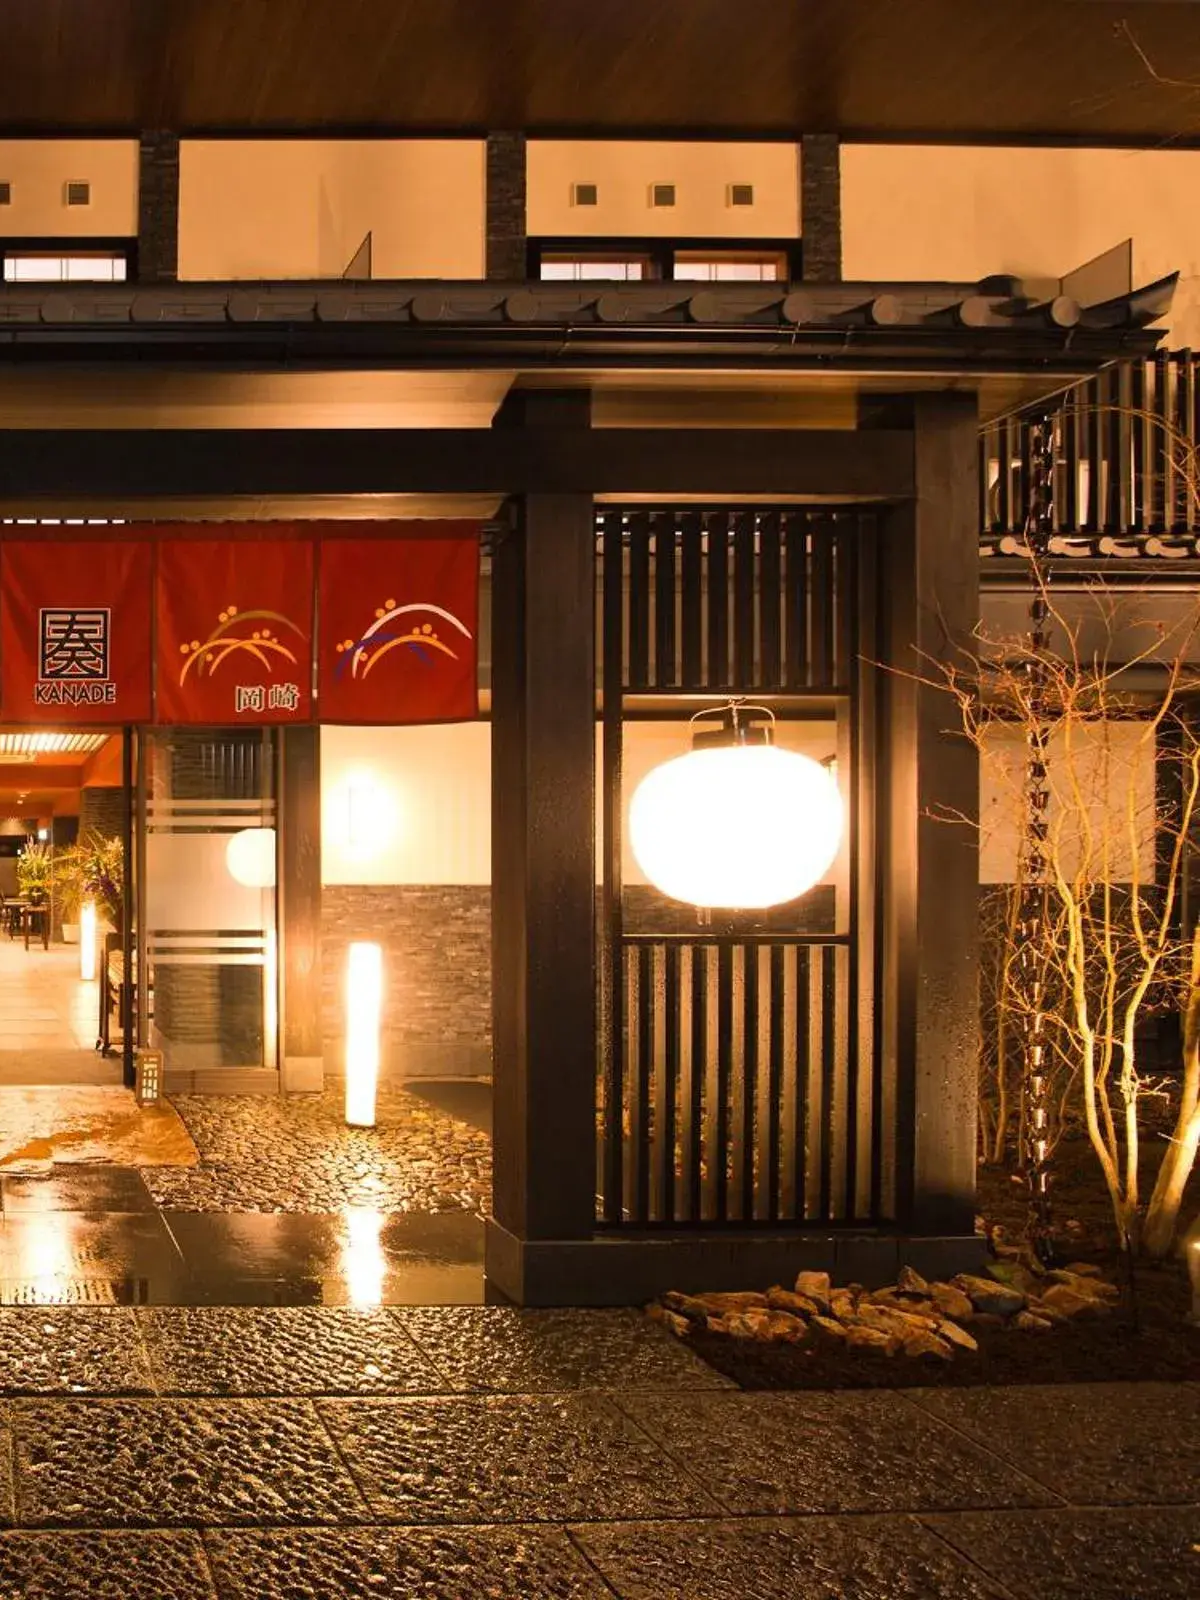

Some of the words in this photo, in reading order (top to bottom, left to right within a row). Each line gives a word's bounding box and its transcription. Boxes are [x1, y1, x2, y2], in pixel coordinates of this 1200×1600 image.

[39, 608, 110, 680] 奏
[34, 682, 116, 704] KANADE
[235, 683, 300, 712] 岡崎
